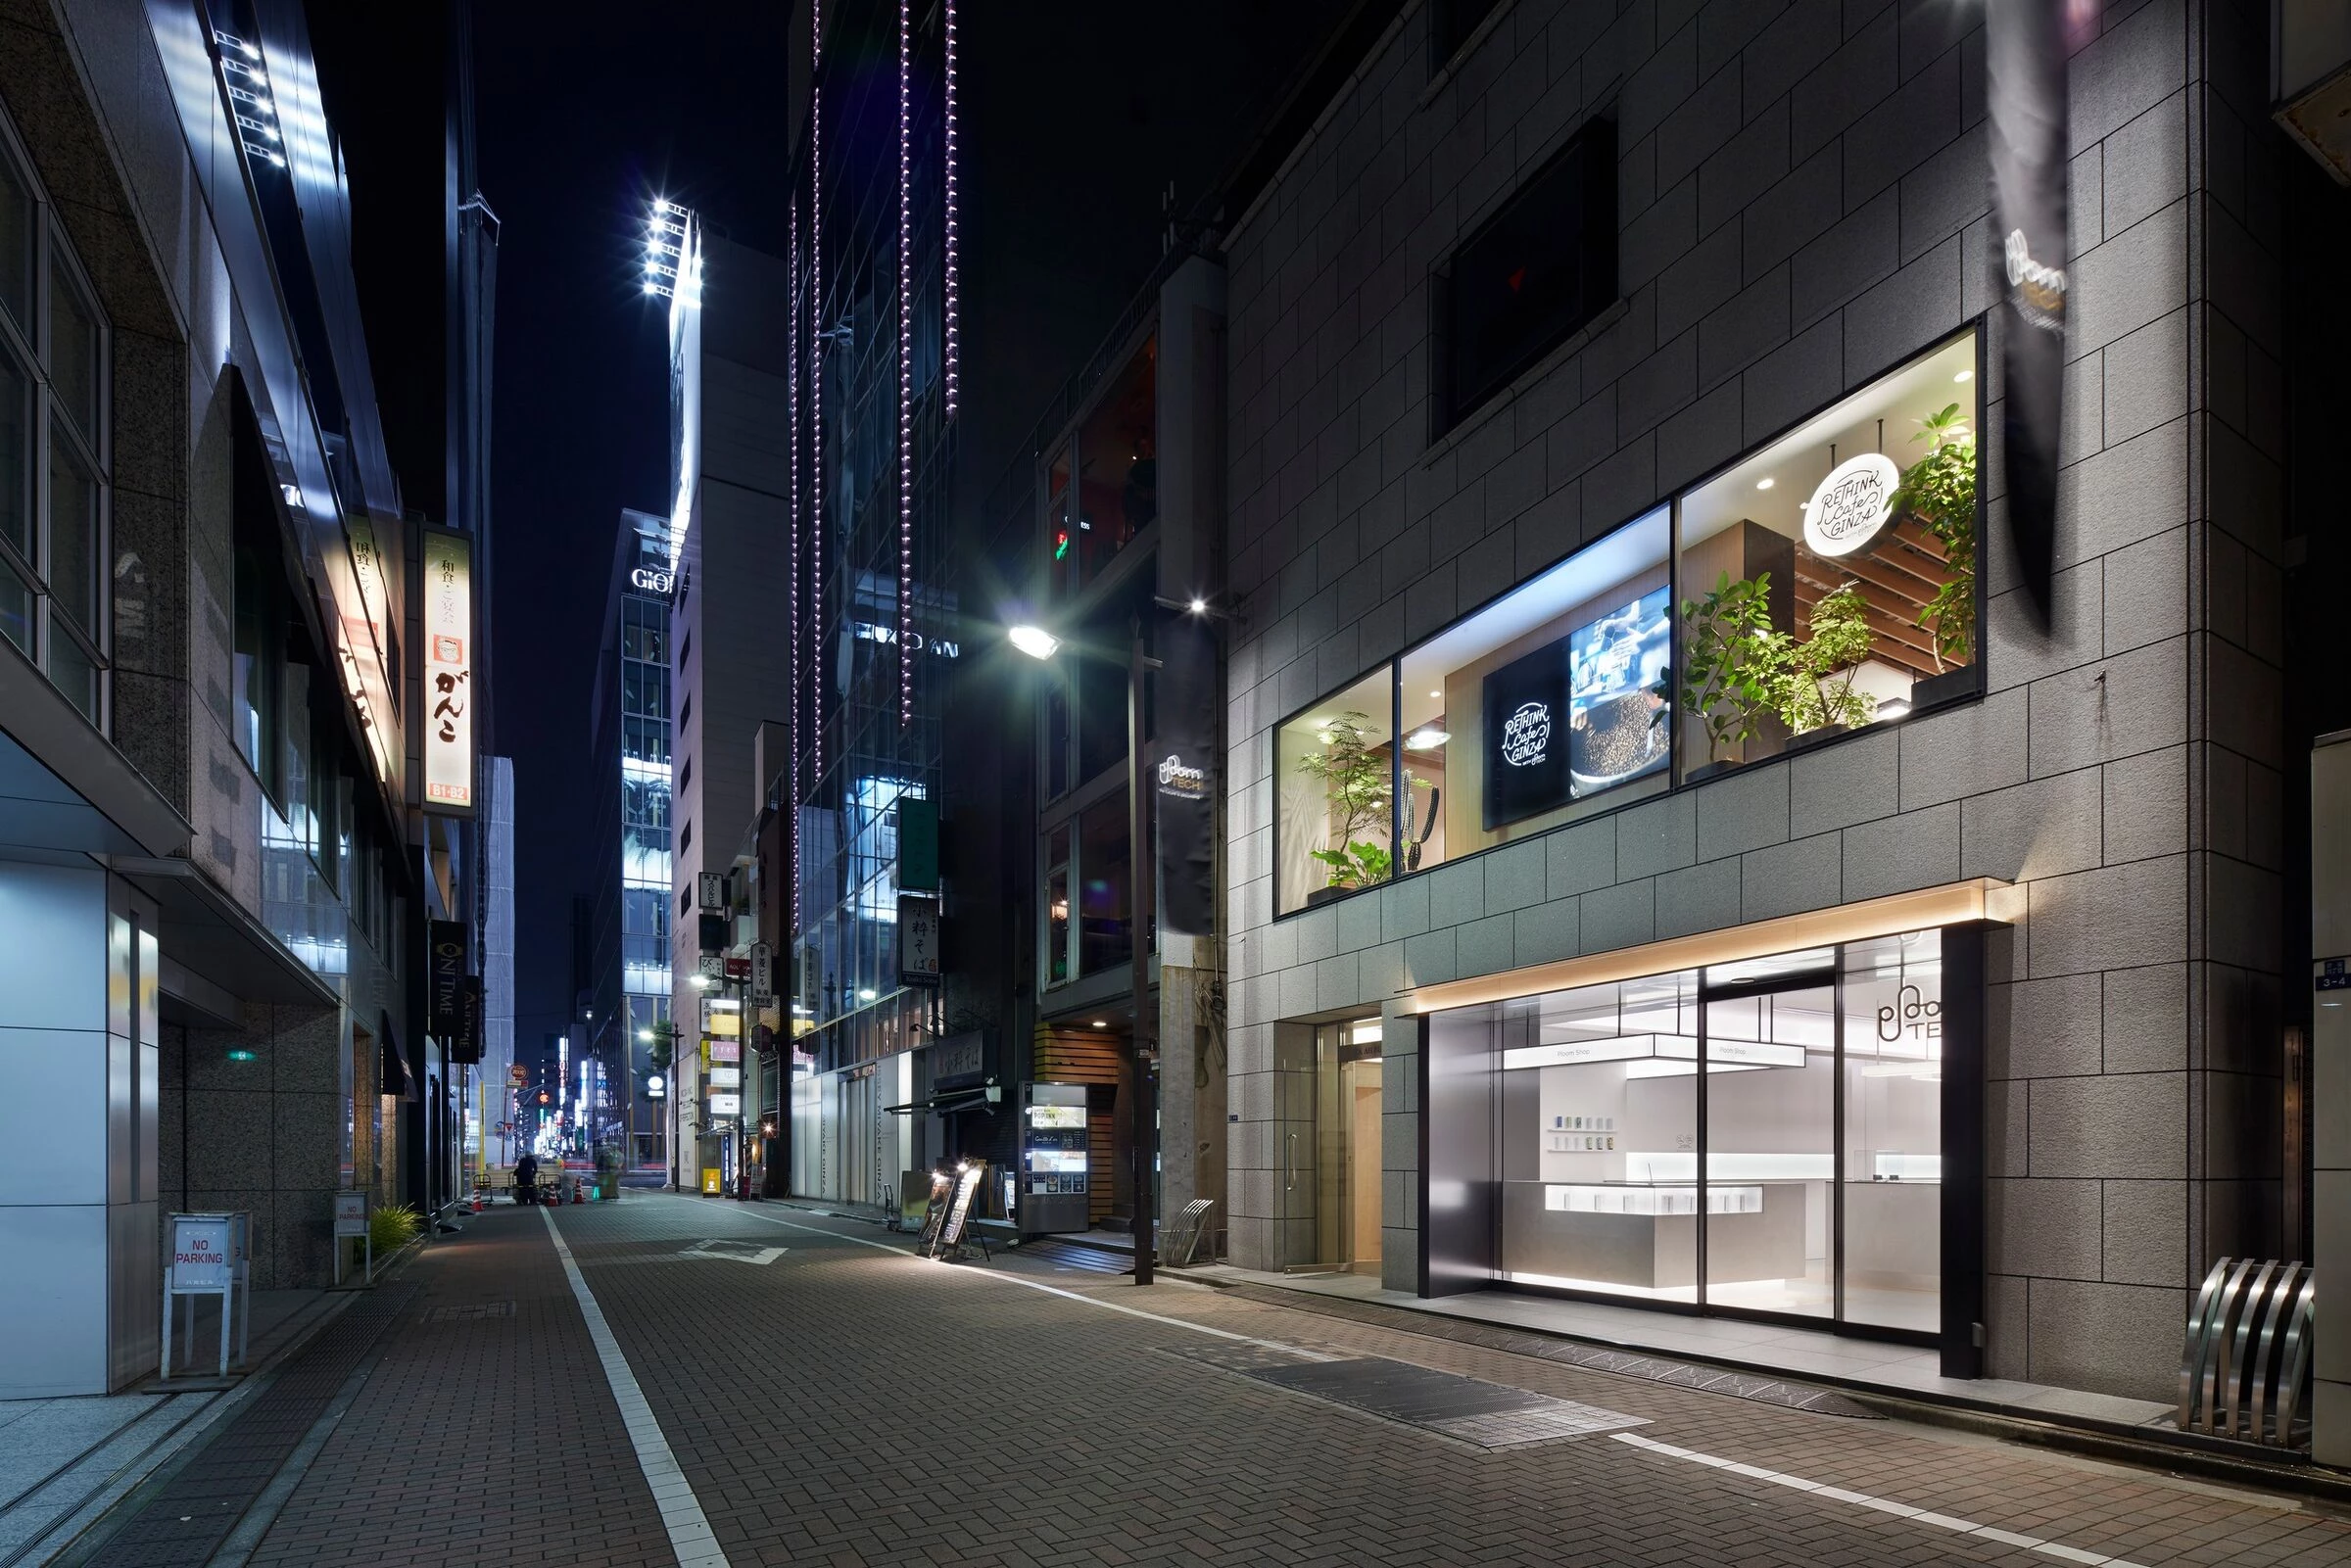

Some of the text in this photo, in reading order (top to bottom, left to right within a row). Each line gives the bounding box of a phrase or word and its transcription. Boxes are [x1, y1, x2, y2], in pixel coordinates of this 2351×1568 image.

[1817, 470, 1883, 525] RETHINK
[1831, 505, 1878, 536] GINZA
[434, 670, 469, 743] がんこ
[1502, 704, 1550, 750] RETHINK
[1511, 736, 1547, 762] GINZA
[1173, 776, 1204, 790] TECH
[1879, 984, 1942, 1042] ploo
[1905, 1022, 1942, 1039] TE
[176, 1253, 223, 1263] PARKING
[192, 1240, 209, 1251] NO
